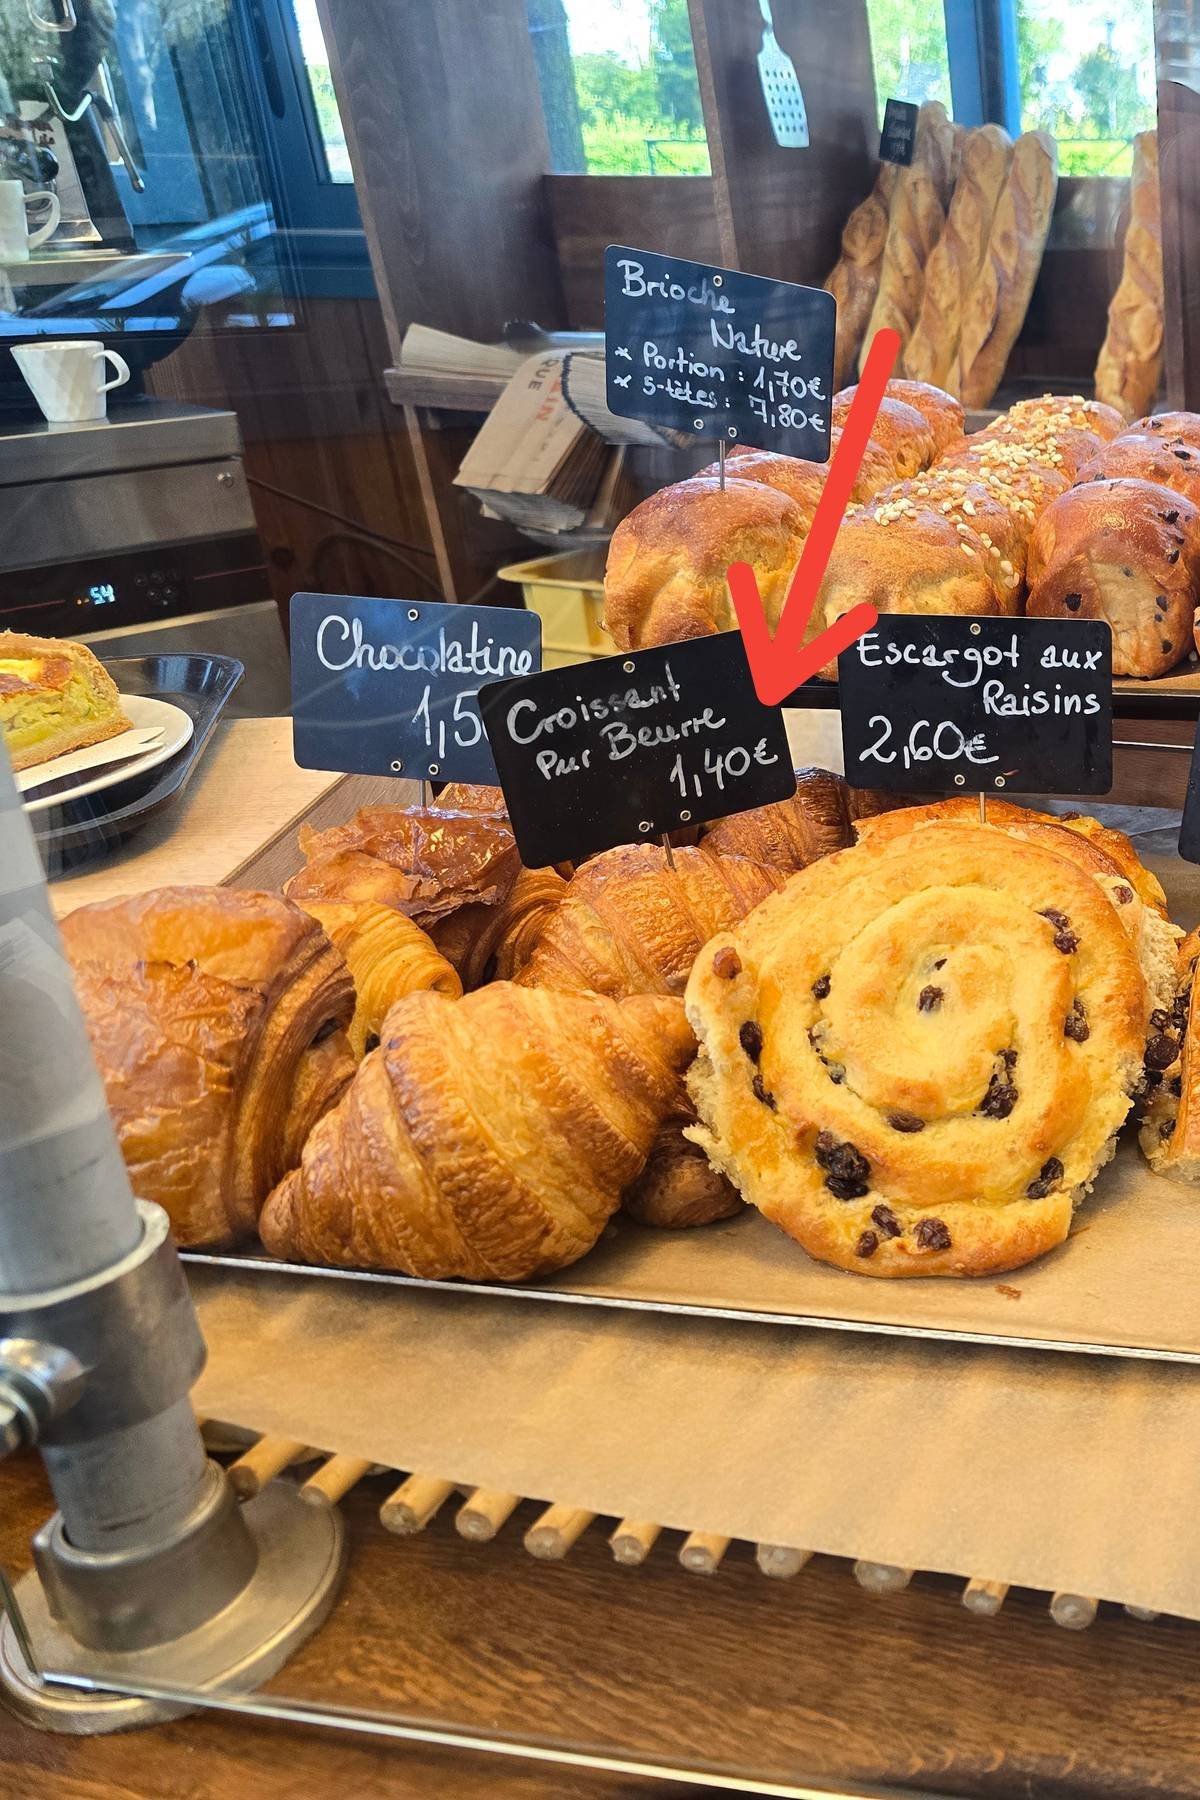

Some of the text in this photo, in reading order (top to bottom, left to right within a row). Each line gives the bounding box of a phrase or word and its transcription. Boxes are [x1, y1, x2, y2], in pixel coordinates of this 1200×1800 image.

[616, 259, 736, 314] Brioche
[710, 318, 802, 363] Nature
[753, 366, 826, 403] 1,70€
[748, 394, 826, 434] 7,80€
[316, 614, 533, 679] Chocolatine
[856, 632, 1103, 688] Escargot aux
[410, 684, 490, 760] 1,5
[506, 659, 682, 746] Croissant
[982, 678, 1102, 718] Raisins
[535, 706, 727, 782] Pur Beurre
[669, 737, 779, 798] 1,40€
[858, 714, 1000, 770] 2,60€
